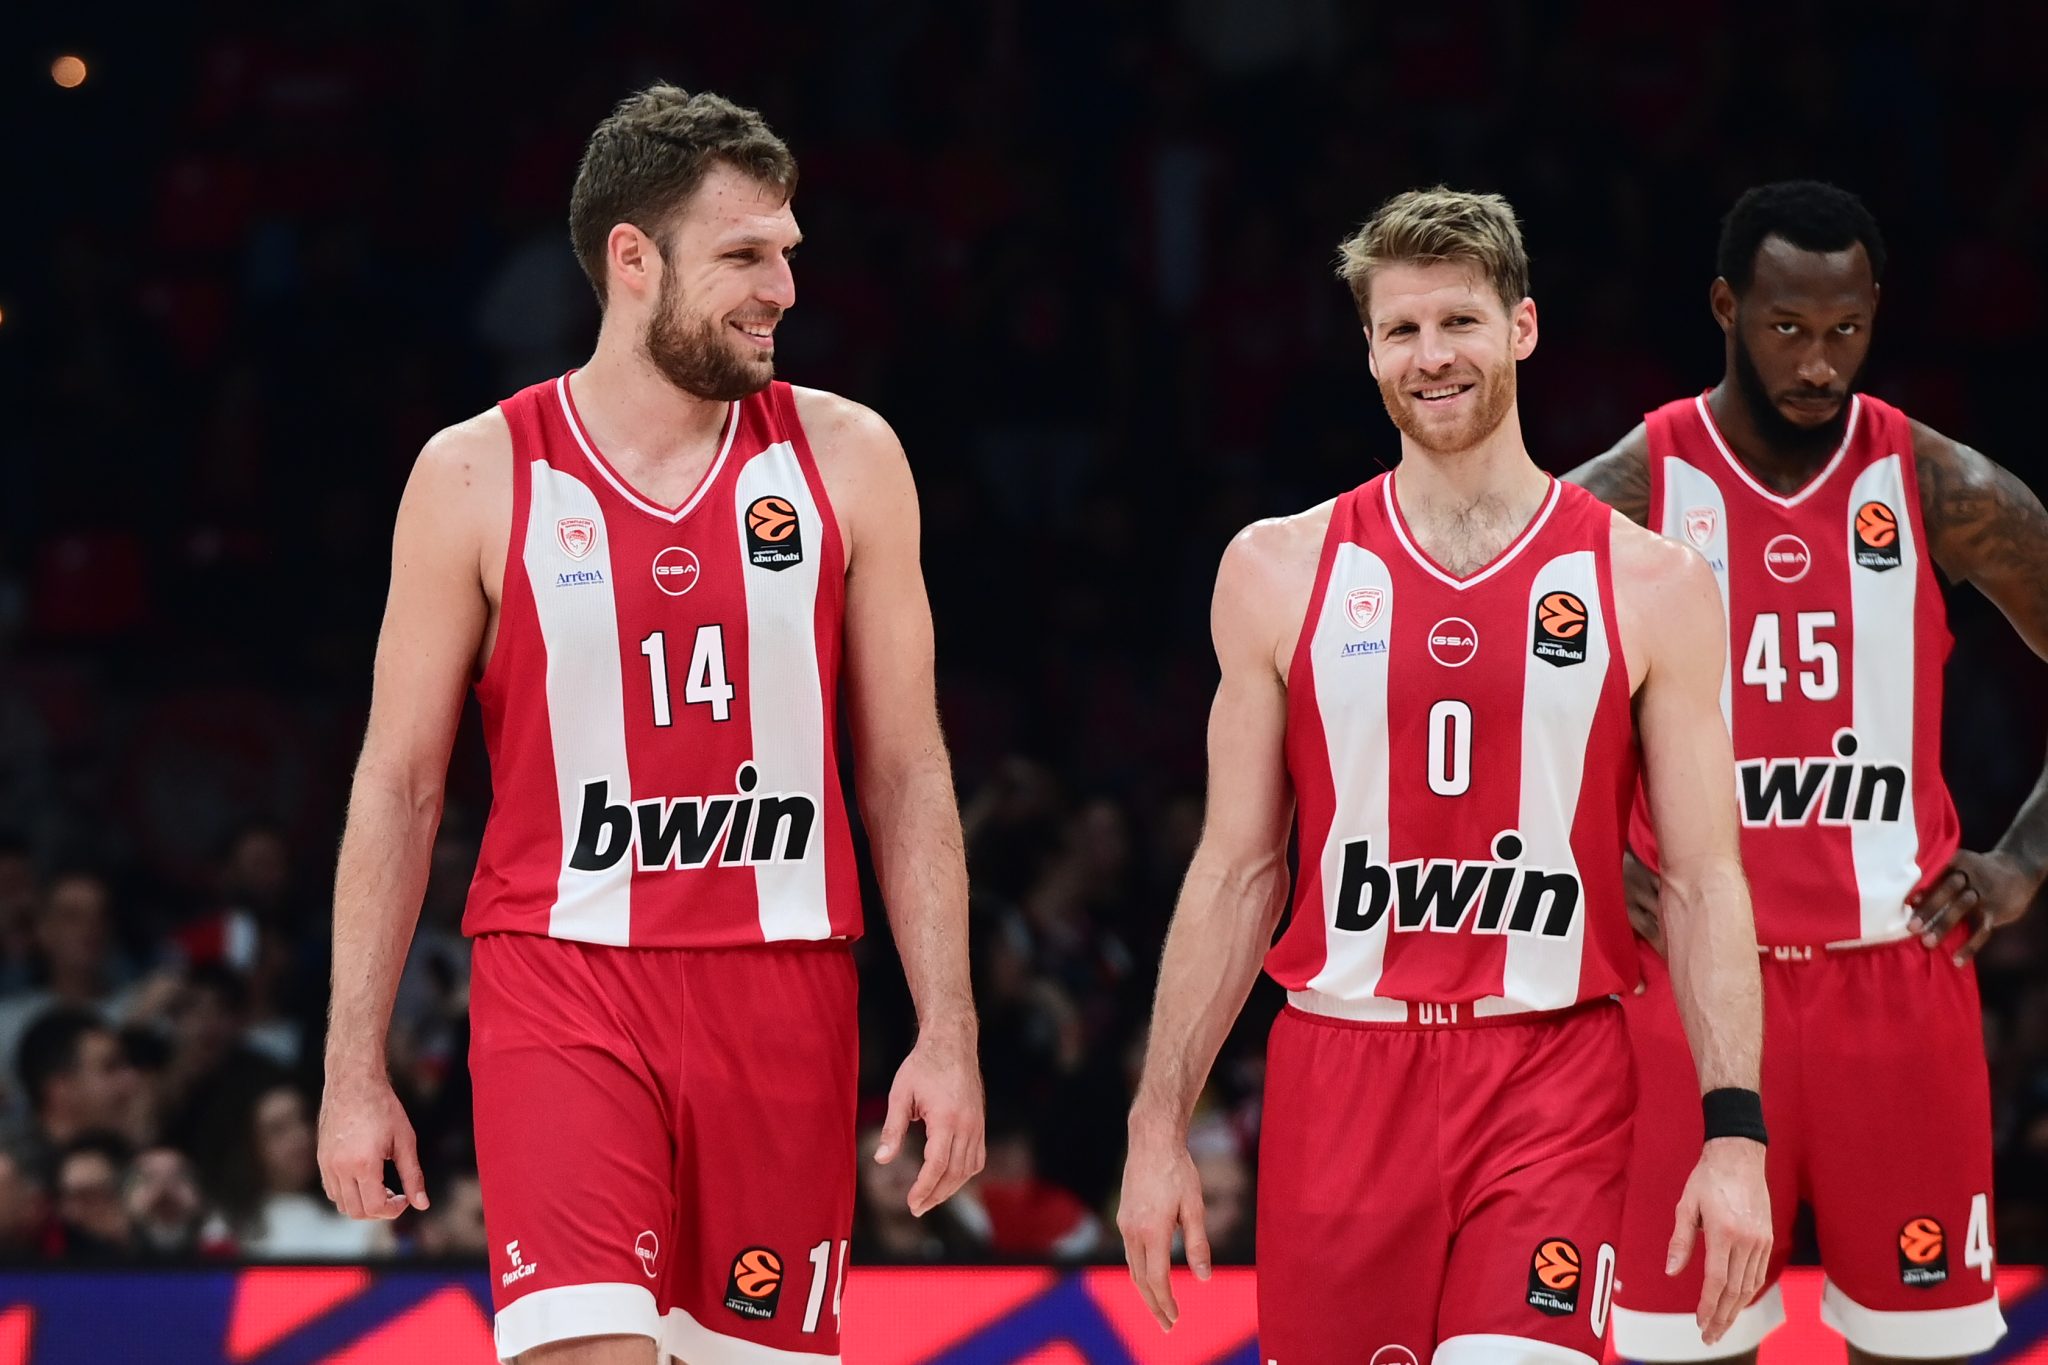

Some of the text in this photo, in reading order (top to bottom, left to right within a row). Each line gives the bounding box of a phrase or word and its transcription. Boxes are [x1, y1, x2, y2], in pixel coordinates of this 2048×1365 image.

[655, 565, 697, 575] GSA
[753, 552, 800, 563] abu dhabi
[640, 624, 736, 728] 14
[1431, 635, 1474, 648] GSA
[1743, 610, 1840, 703] 45
[1427, 698, 1473, 797] 0
[1738, 731, 1907, 824] win
[567, 763, 818, 873] bwin
[1333, 833, 1581, 938] bwin
